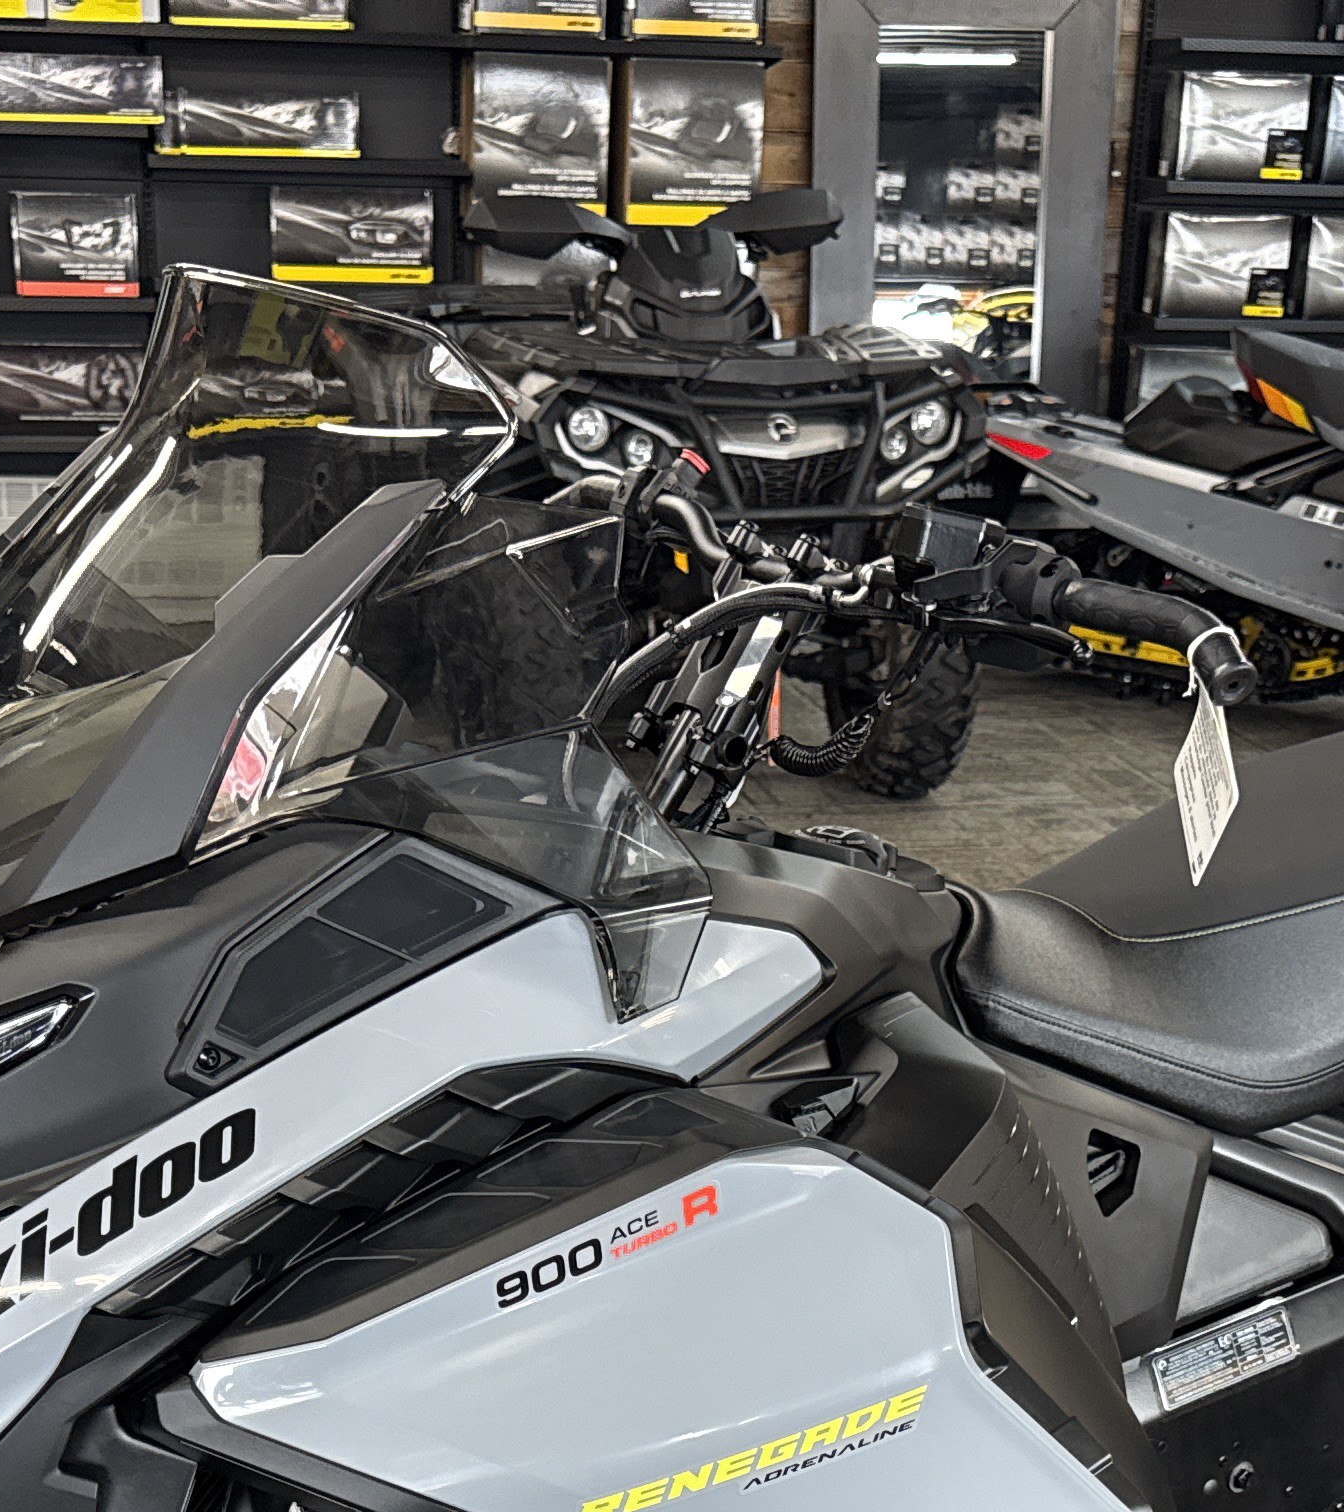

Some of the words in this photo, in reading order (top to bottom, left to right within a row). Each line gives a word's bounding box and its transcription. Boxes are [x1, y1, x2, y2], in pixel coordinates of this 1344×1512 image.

[609, 1209, 660, 1245] ACE
[681, 1184, 719, 1228] R
[496, 1238, 603, 1309] 900
[609, 1221, 678, 1261] TURBO
[743, 1418, 916, 1491] ADRENALINE
